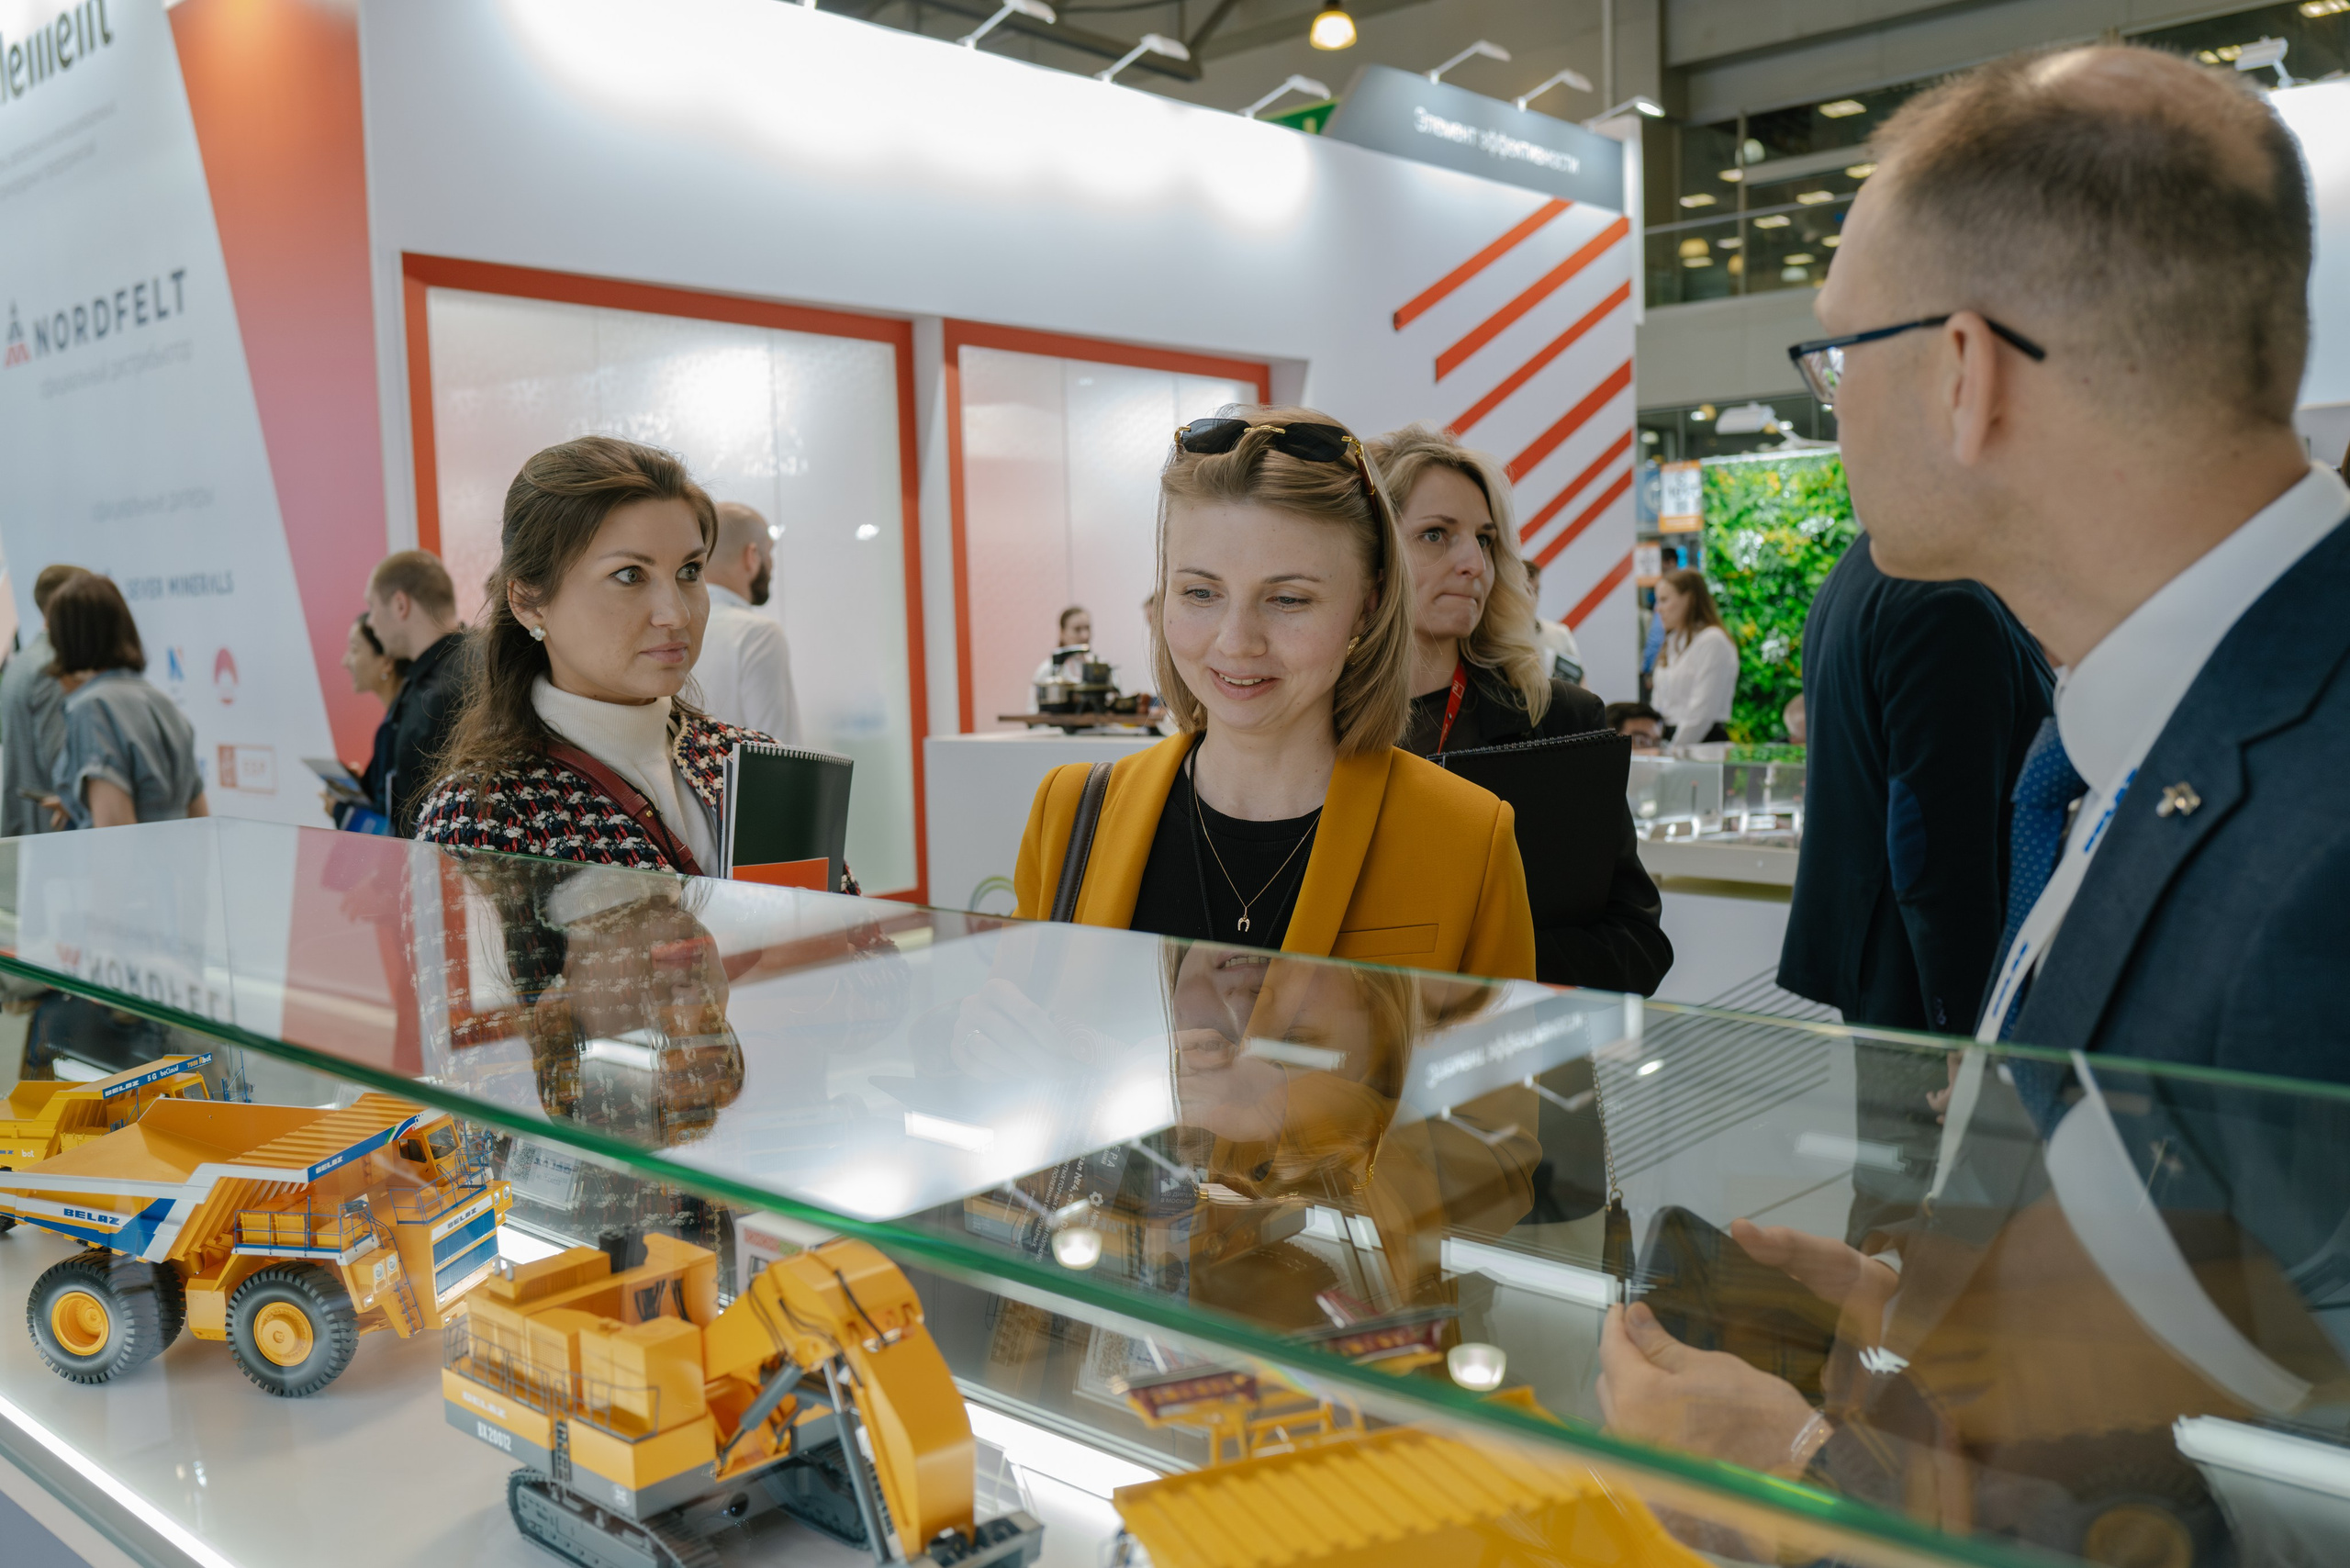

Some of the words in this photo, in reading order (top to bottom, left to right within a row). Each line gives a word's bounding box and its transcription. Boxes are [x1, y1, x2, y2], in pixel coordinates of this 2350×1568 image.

[34, 267, 187, 361] NORDFELT
[105, 1081, 140, 1097] BELAZ
[316, 1156, 343, 1174] BELAZ
[63, 1208, 120, 1226] BELAZ
[447, 1207, 477, 1229] BELAZ
[462, 1391, 507, 1418] BELAZ
